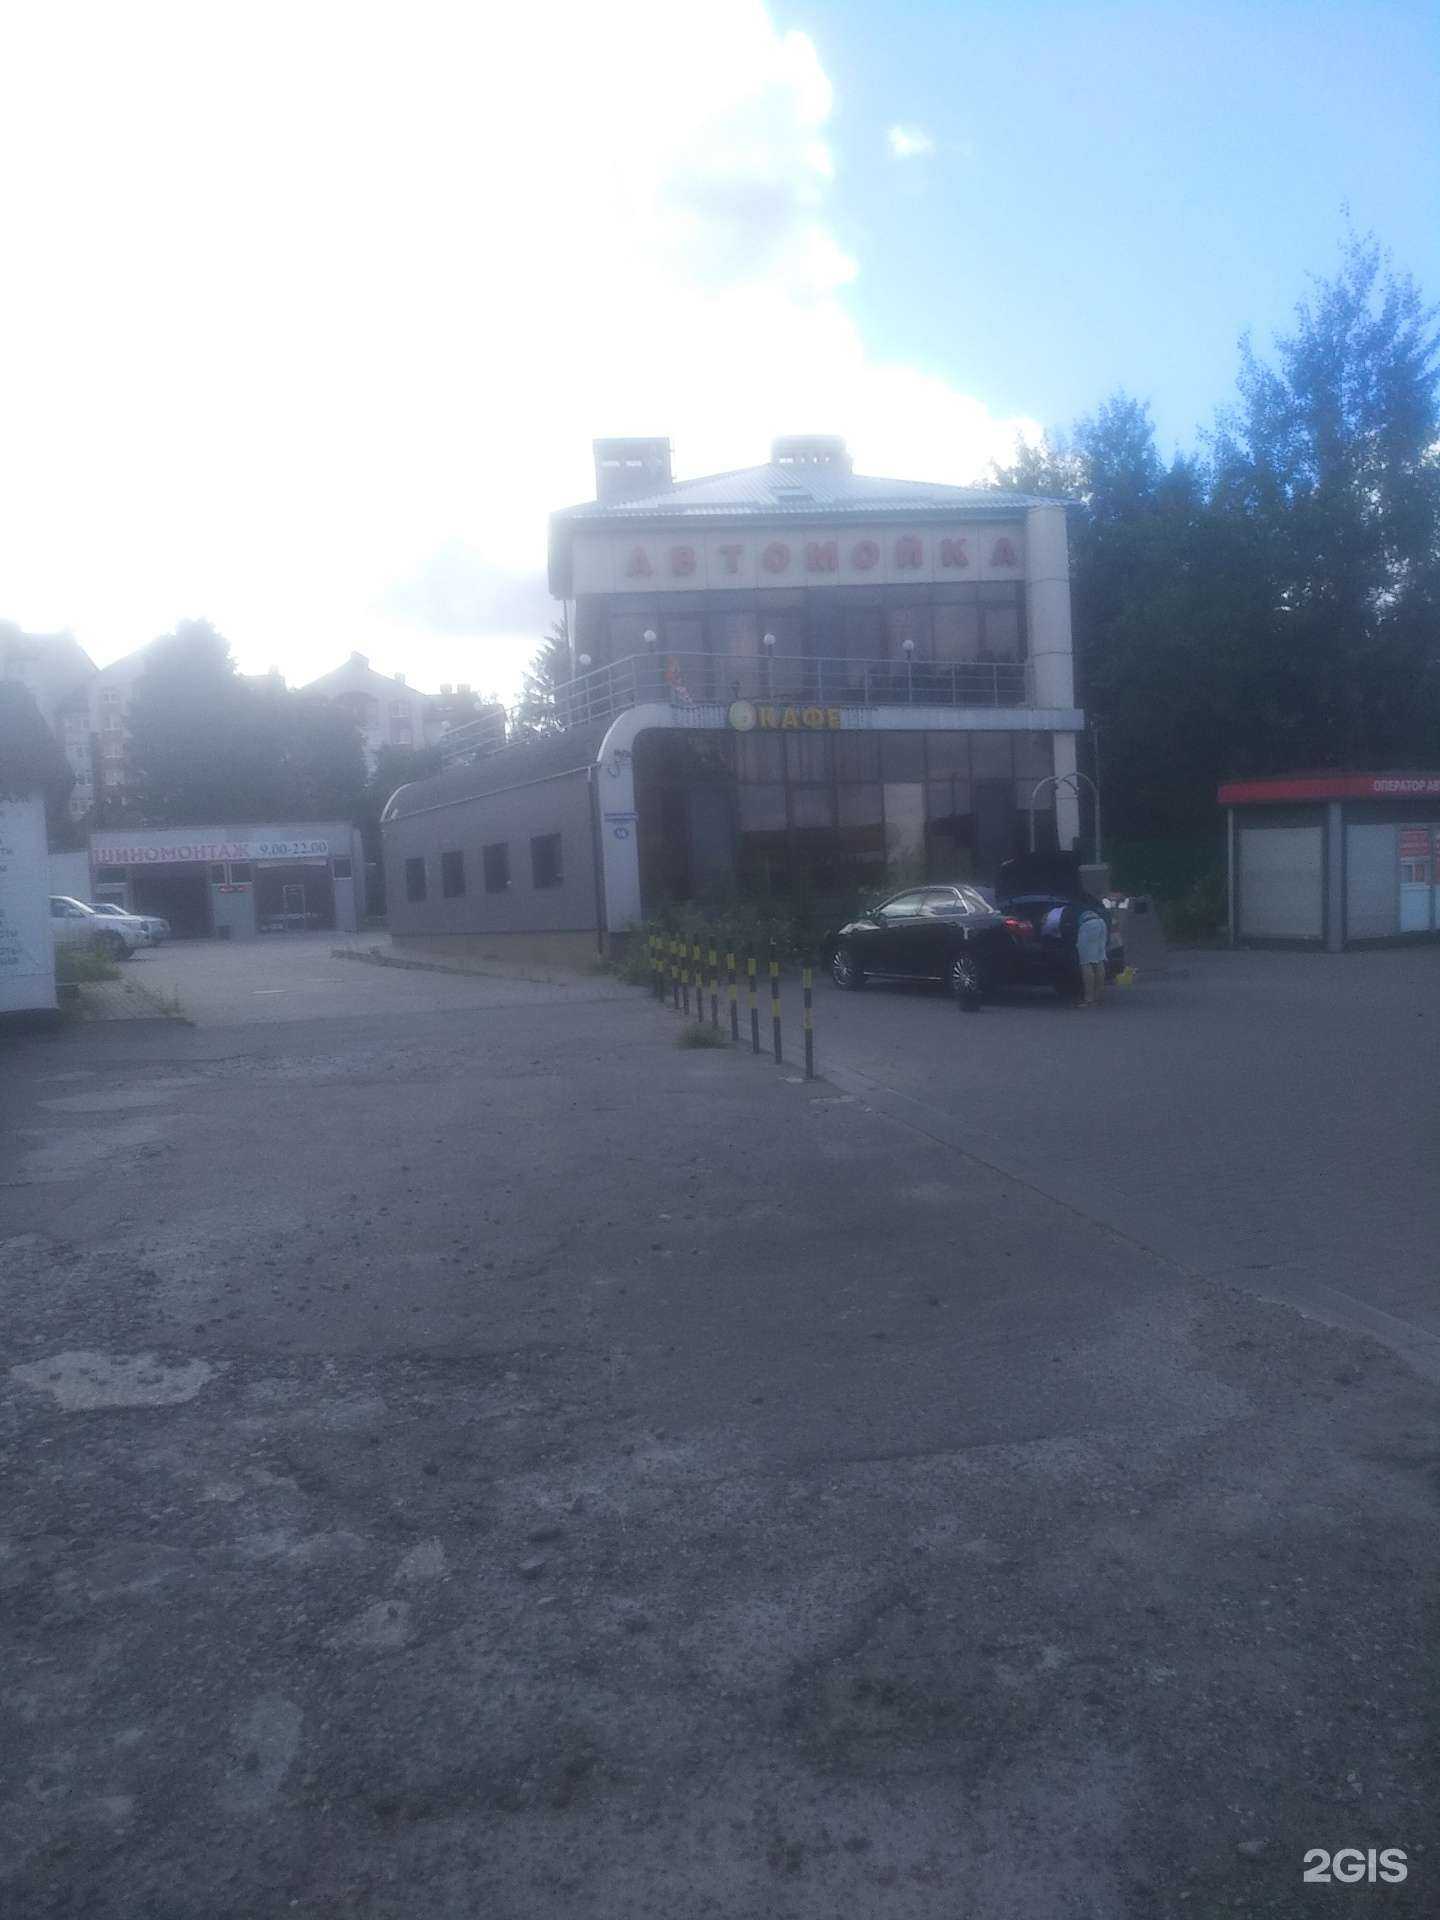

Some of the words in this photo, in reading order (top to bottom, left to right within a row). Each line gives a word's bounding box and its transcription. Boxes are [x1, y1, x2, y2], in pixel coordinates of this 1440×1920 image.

[626, 535, 1019, 577] АВТОМОЙКА
[758, 707, 841, 730] КАФЕ
[93, 843, 249, 865] ШИНОМОНТАЖ
